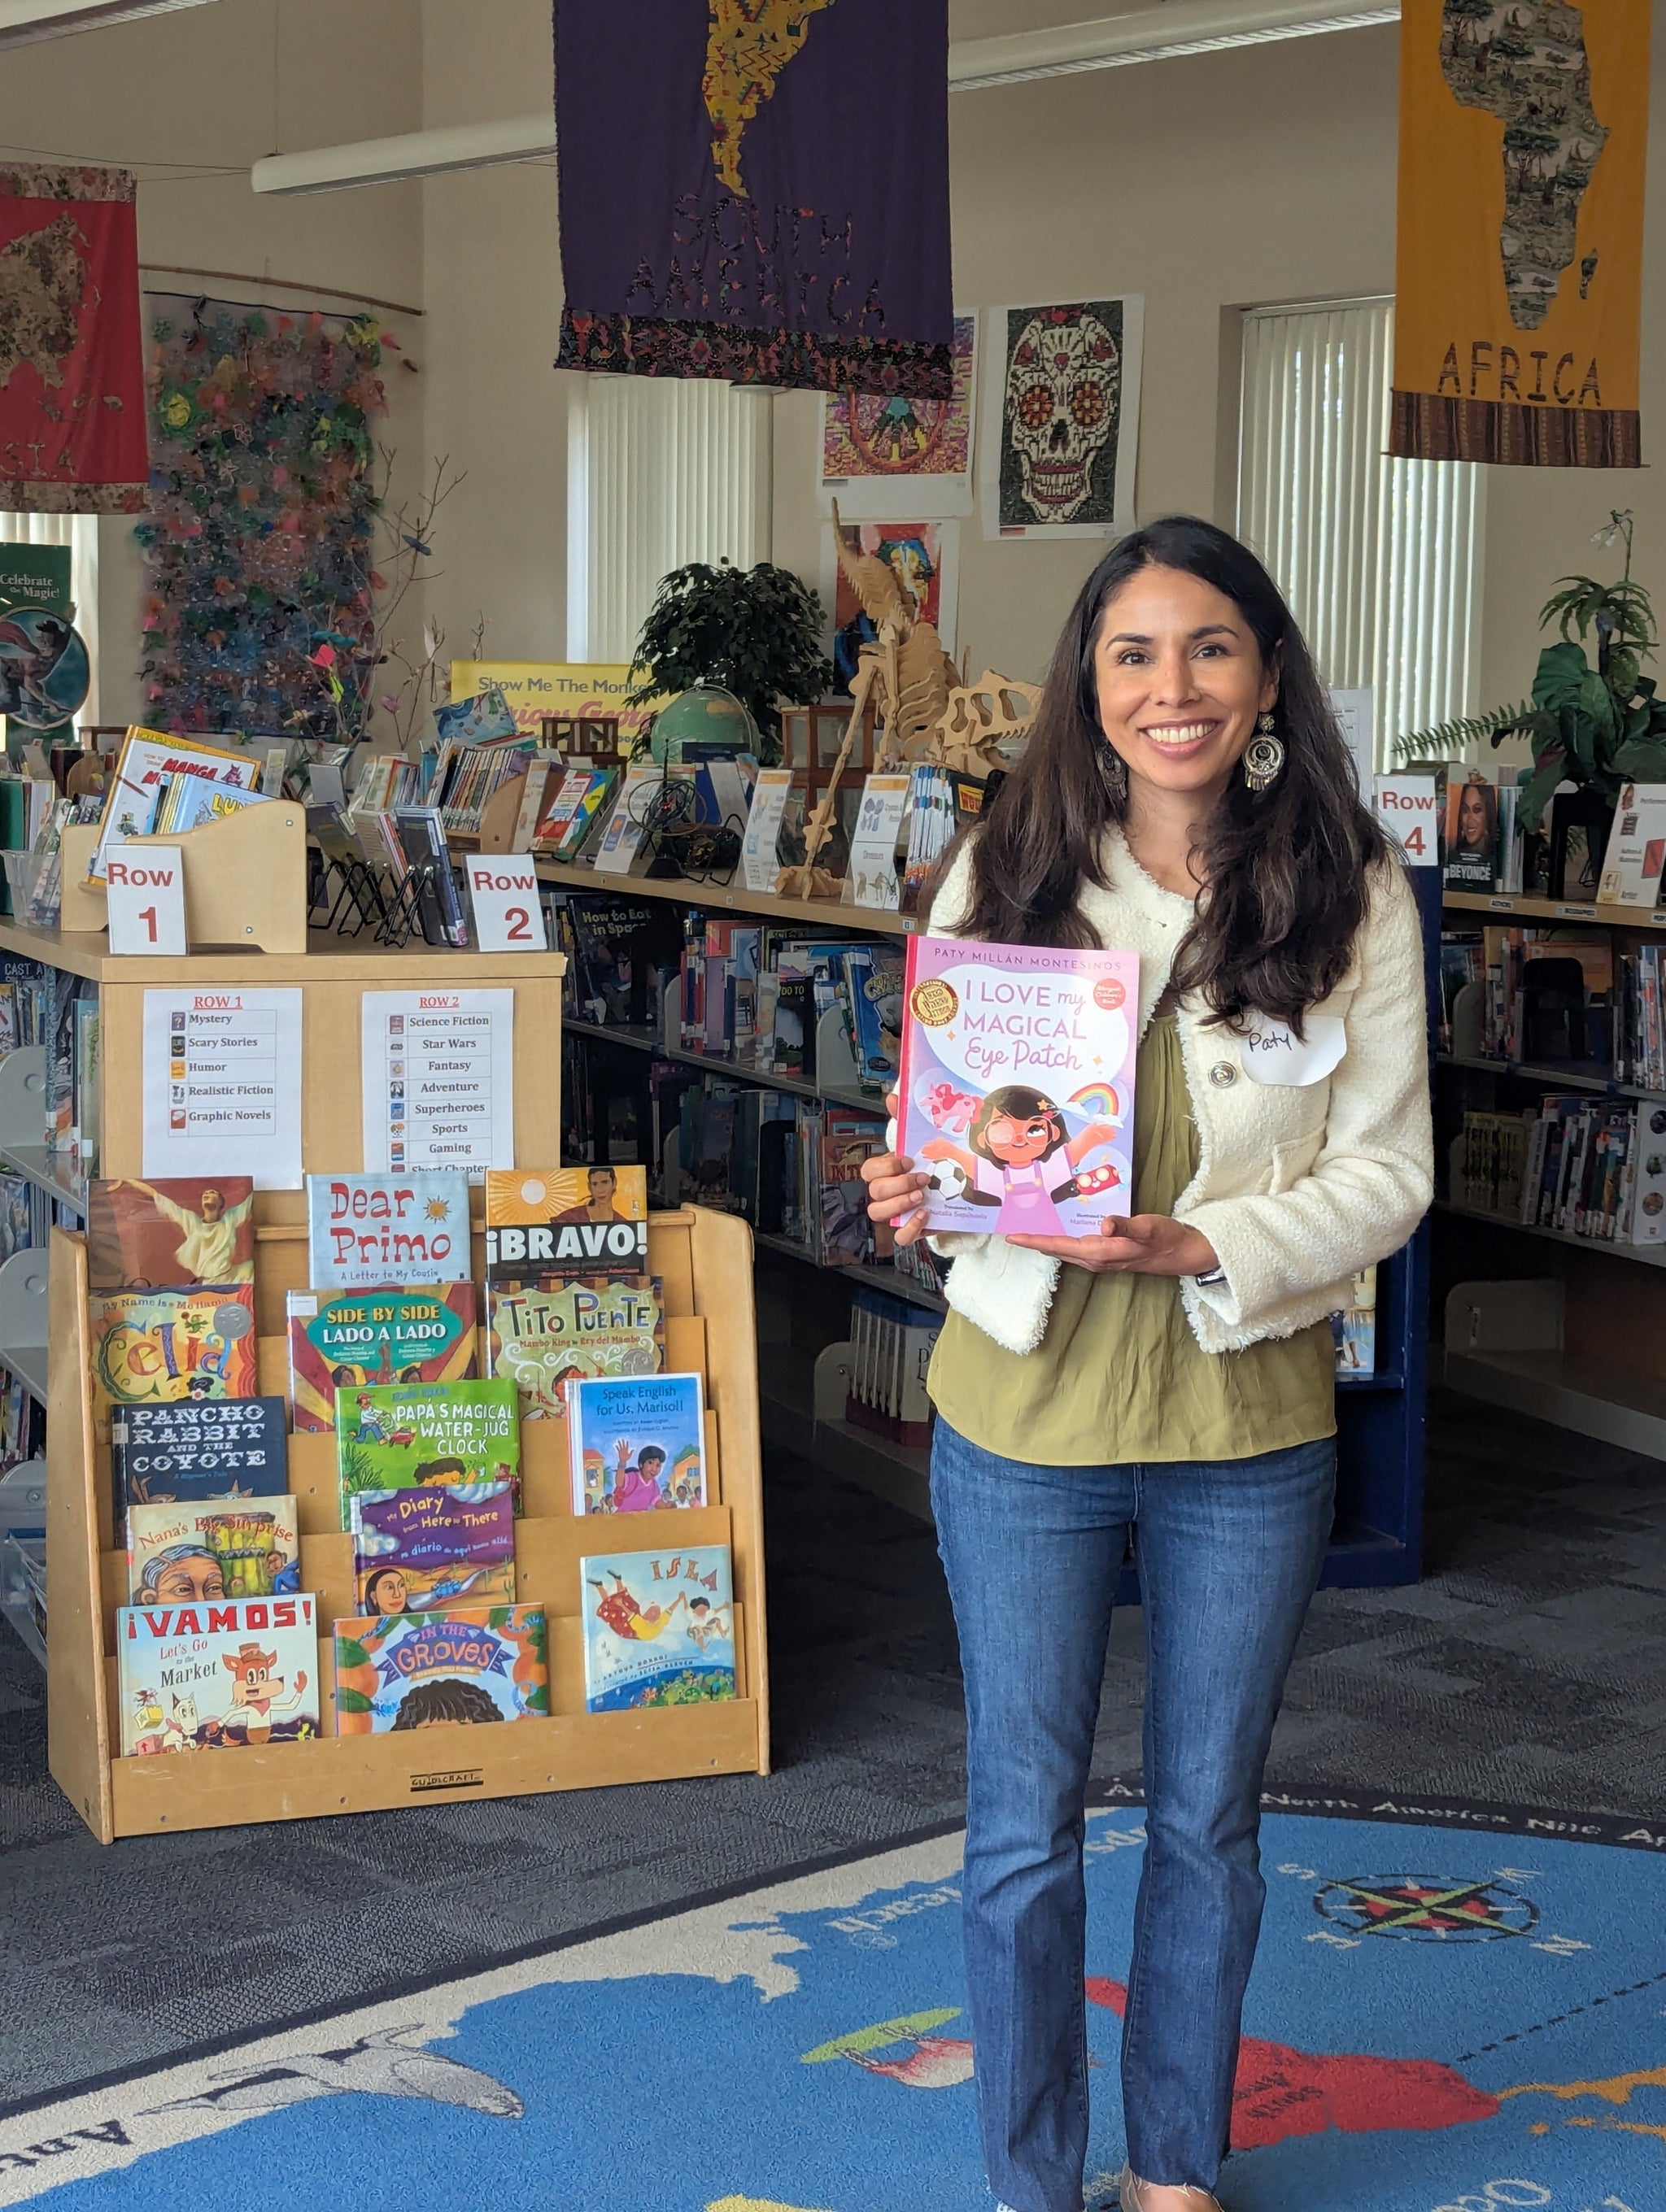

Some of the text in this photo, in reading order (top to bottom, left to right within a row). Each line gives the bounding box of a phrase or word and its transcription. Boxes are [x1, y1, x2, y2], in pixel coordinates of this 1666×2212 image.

[673, 194, 853, 255] SOUTH
[626, 255, 886, 329] AMERICA
[1437, 342, 1601, 406] AFRICA
[0, 573, 53, 586] Celebrate
[478, 677, 652, 694] Show Me The Monke
[161, 758, 218, 780] MANGA
[1382, 791, 1434, 809] Row
[1404, 827, 1426, 856] 4
[108, 863, 173, 887] Row
[473, 872, 534, 890] Row
[138, 907, 158, 942] 1
[505, 908, 533, 939] 2
[582, 912, 608, 923] How
[611, 910, 626, 921] to
[935, 947, 1122, 971] PATY MILLÁN MONTESINOS
[5, 963, 31, 975] CAST
[194, 995, 242, 1008] ROW 1
[420, 996, 460, 1008] ROW 2
[966, 979, 971, 1000] I
[981, 982, 1051, 1007] LOVE
[1058, 991, 1087, 1014] my
[189, 1013, 233, 1027] Mystery
[409, 1015, 490, 1027] Science Fiction
[963, 1011, 1088, 1040] MAGICAL
[189, 1036, 258, 1050] Scary Stories
[422, 1038, 477, 1050] Star Wars
[1249, 1030, 1292, 1052] Paty
[964, 1037, 1083, 1078] Eye Patch
[189, 1062, 227, 1073] Humor
[428, 1060, 472, 1074] Fantasy
[189, 1084, 273, 1096] Realistic Fiction
[421, 1081, 479, 1093] Adventure
[189, 1109, 271, 1123] Graphic Novels
[415, 1102, 486, 1117] Superheroes
[432, 1122, 468, 1137] Sports
[429, 1143, 472, 1156] Gaming
[447, 1163, 490, 1175] Chapter
[330, 1182, 415, 1219] Dear
[329, 1226, 451, 1265] Primo
[486, 1221, 648, 1265] ¡BRAVO!
[341, 1269, 438, 1280] A Letter to My Cousin
[327, 1304, 441, 1324] SIDE BY SIDE
[323, 1323, 447, 1343] LADO A LADO
[520, 1339, 550, 1348] Mambo
[552, 1338, 570, 1348] King
[612, 1335, 640, 1343] Mambo
[603, 1385, 676, 1401] Speak English
[132, 1404, 265, 1426] PANCHO
[452, 1404, 514, 1419] MAGICAL
[596, 1404, 613, 1416] for
[638, 1400, 683, 1414] Marisol!
[132, 1423, 265, 1445] RABBIT
[420, 1421, 509, 1438] WATER-JUG
[167, 1442, 233, 1453] AND THE
[437, 1439, 488, 1455] CLOCK
[133, 1450, 266, 1472] COYOTE
[399, 1496, 444, 1518] Diary
[421, 1514, 452, 1529] Here
[462, 1511, 499, 1527] There
[138, 1514, 294, 1550] Nana's Big Surprise
[650, 1557, 717, 1592] ISLA
[128, 1600, 312, 1639] ¡VAMOS!
[420, 1624, 467, 1641] IN THE
[160, 1639, 208, 1661] Let's Go
[397, 1641, 493, 1672] GROVES
[160, 1661, 217, 1688] Market
[1260, 1792, 1359, 1810] North
[1372, 1801, 1511, 1824] America
[1525, 1818, 1602, 1835] Nile
